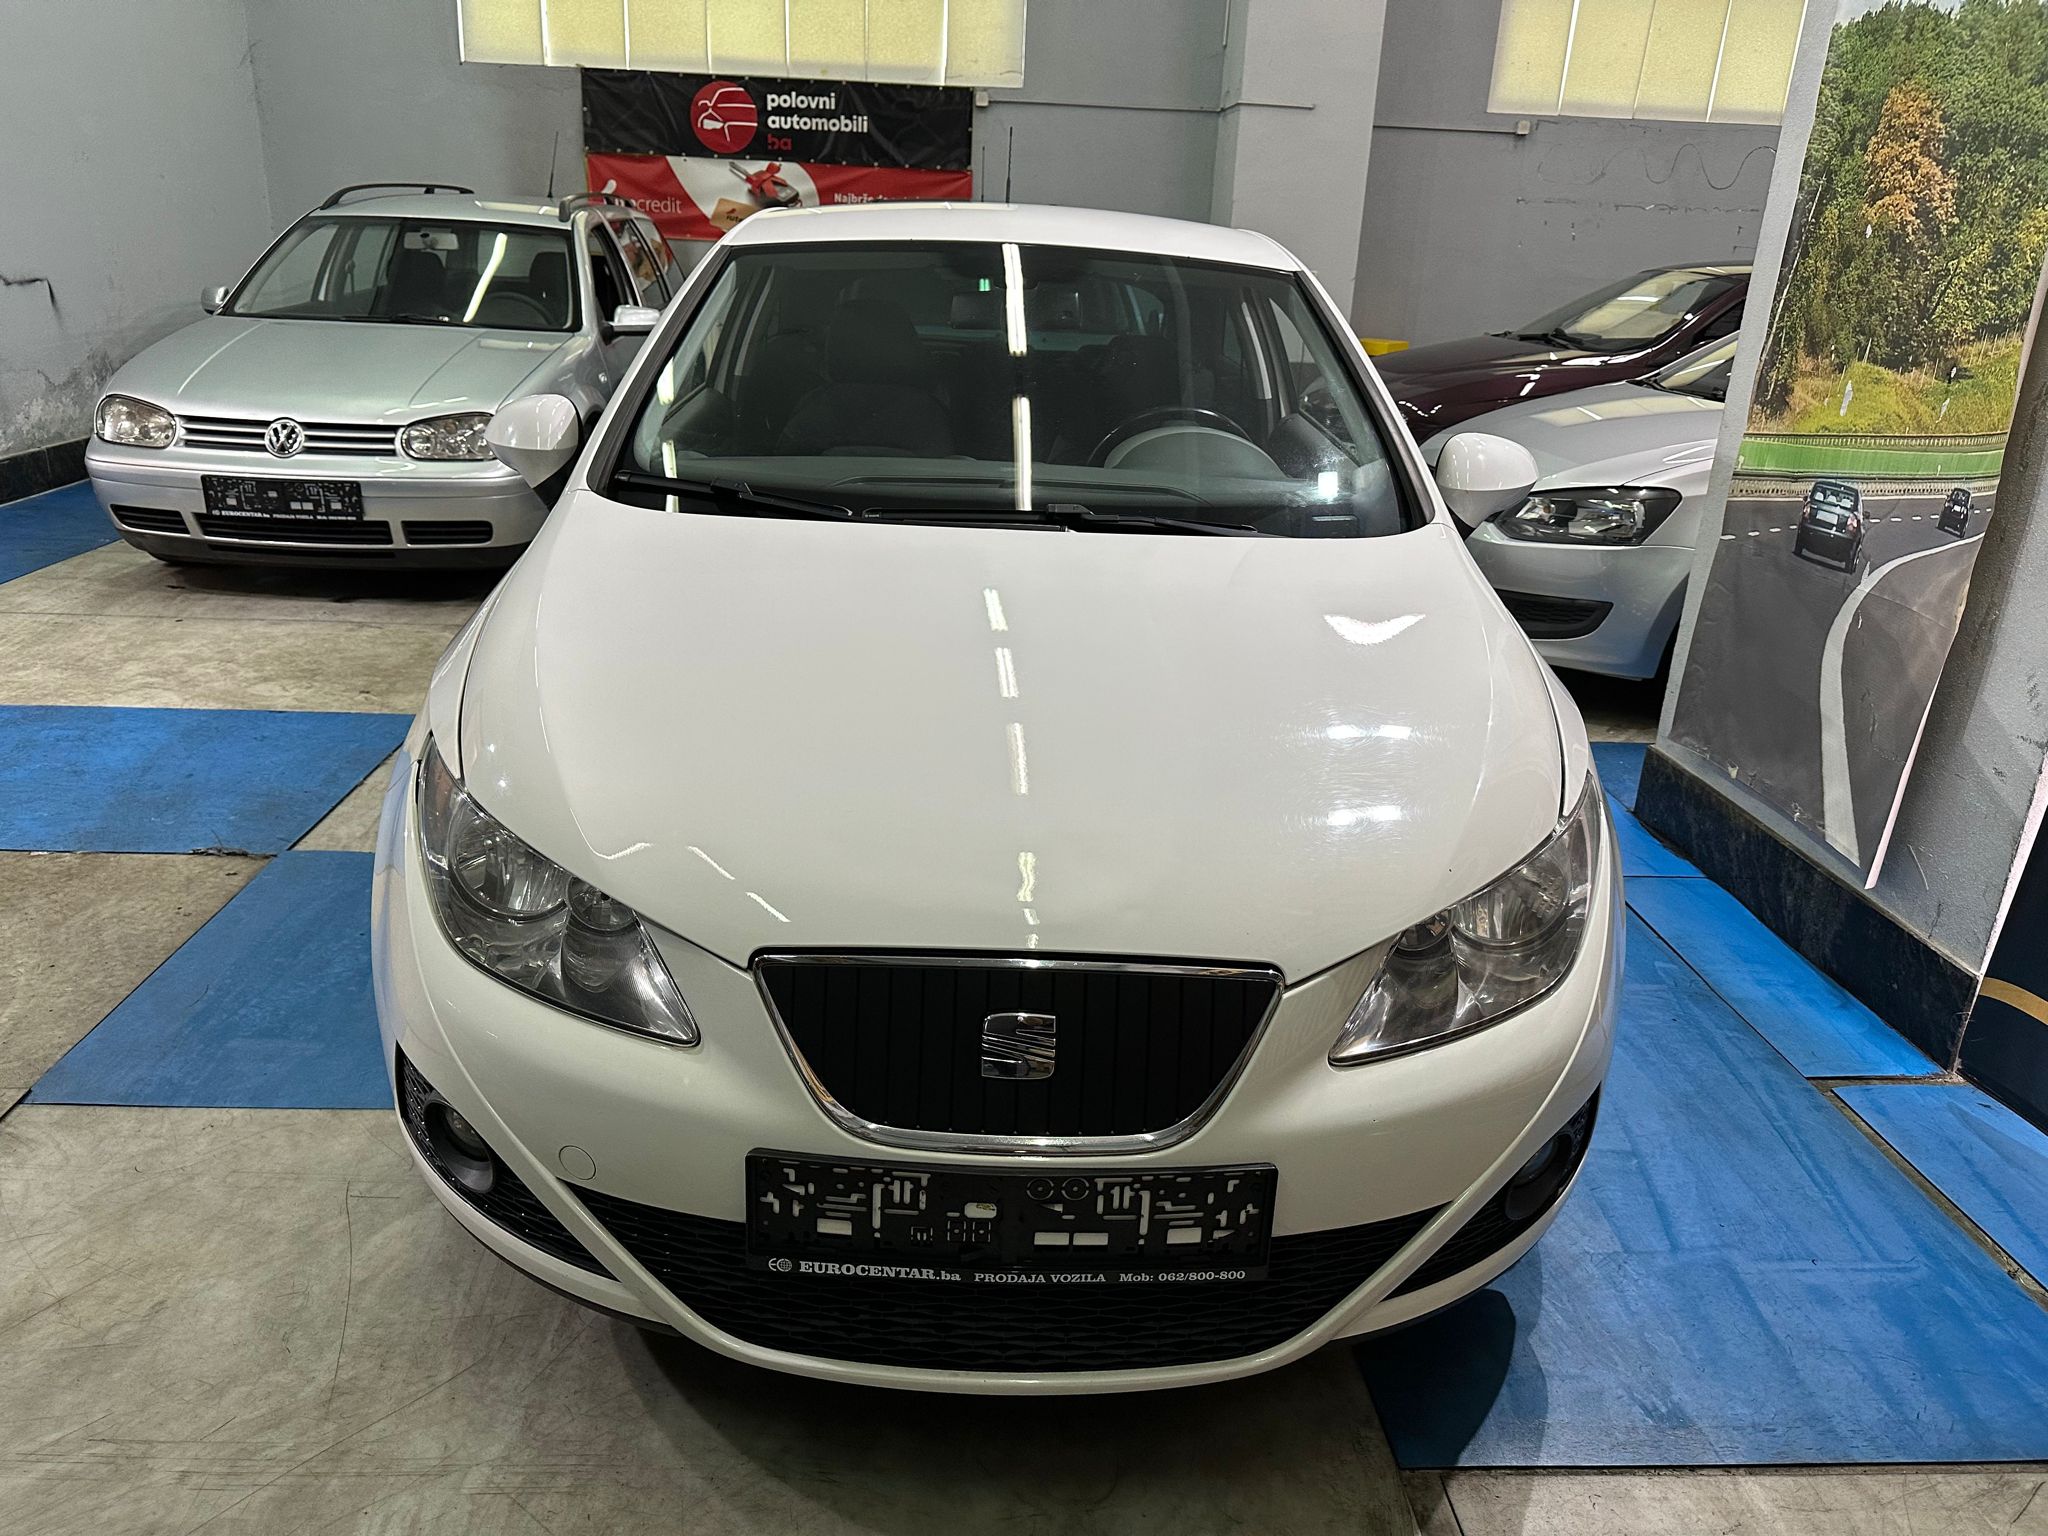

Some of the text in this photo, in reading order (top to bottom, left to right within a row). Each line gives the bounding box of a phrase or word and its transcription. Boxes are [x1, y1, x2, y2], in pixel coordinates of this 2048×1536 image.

[766, 91, 836, 111] polovni
[767, 114, 868, 133] automobili
[767, 134, 793, 150] ba
[799, 1261, 961, 1281] EUROCENTAR.ba
[974, 1272, 1046, 1283] PRODAJA
[1050, 1273, 1106, 1283] VOZILA
[1119, 1273, 1154, 1283] Mob:
[1158, 1270, 1246, 1282] 062/800-800
